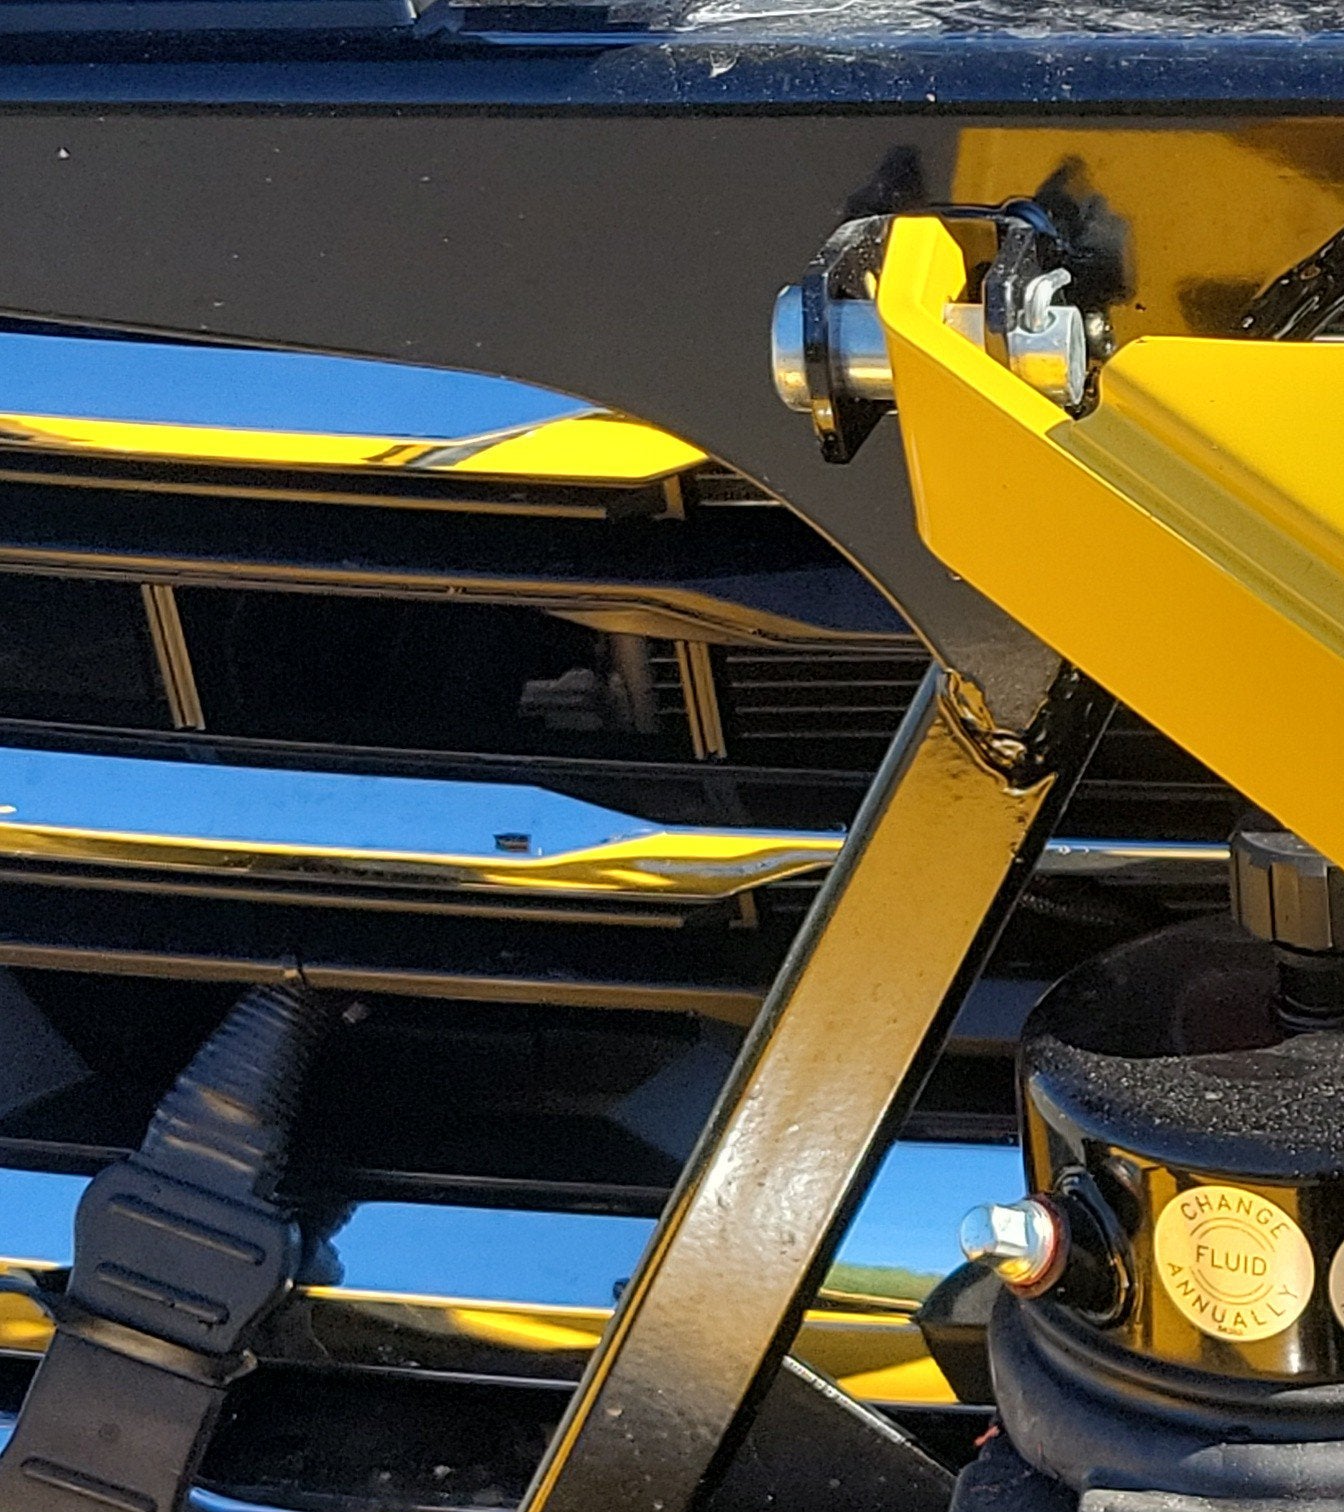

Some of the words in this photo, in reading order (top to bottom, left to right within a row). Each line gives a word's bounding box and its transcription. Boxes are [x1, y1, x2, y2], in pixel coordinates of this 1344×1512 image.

[1181, 1196, 1291, 1241] CHANGE
[1195, 1244, 1268, 1277] FLUID
[1167, 1261, 1299, 1328] ANNUALLY
